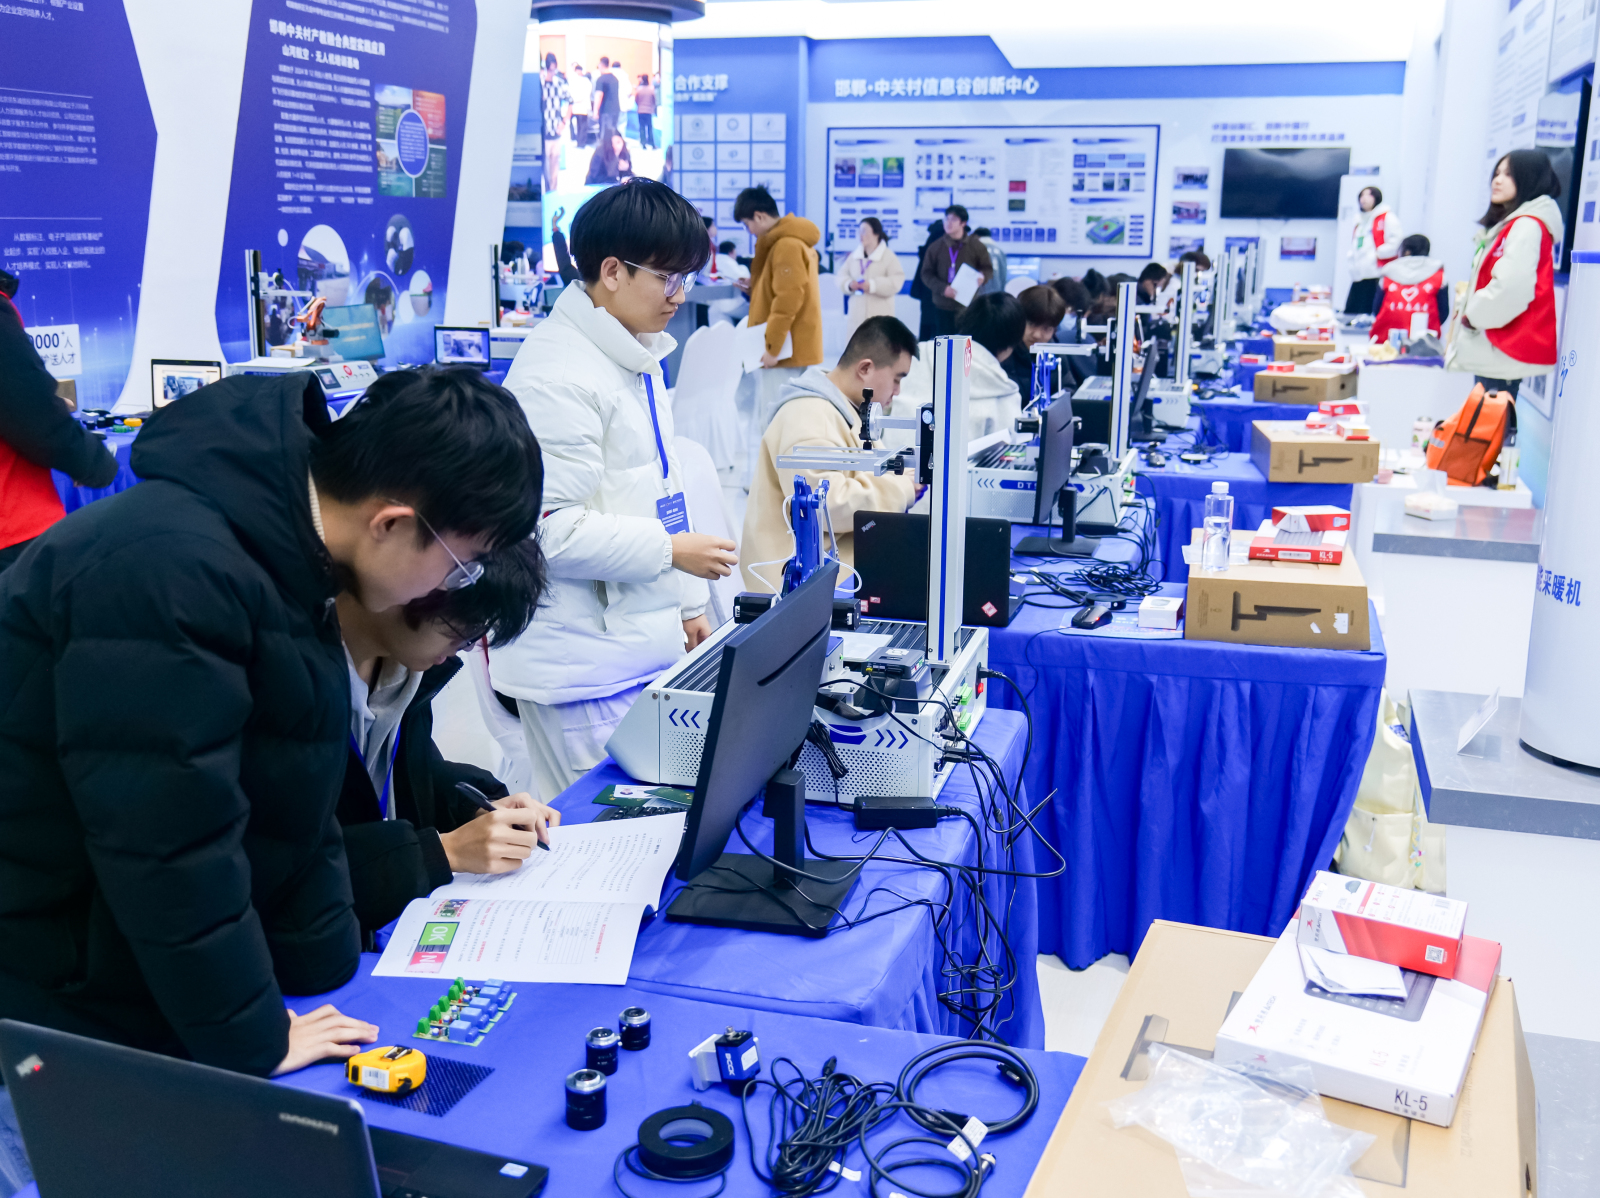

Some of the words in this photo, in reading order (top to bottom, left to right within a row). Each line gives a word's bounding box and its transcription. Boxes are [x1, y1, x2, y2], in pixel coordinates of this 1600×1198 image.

[834, 75, 1040, 98] 邯郸·中关村信息谷创新中心
[428, 926, 449, 942] OK
[1394, 1088, 1428, 1110] KL-5
